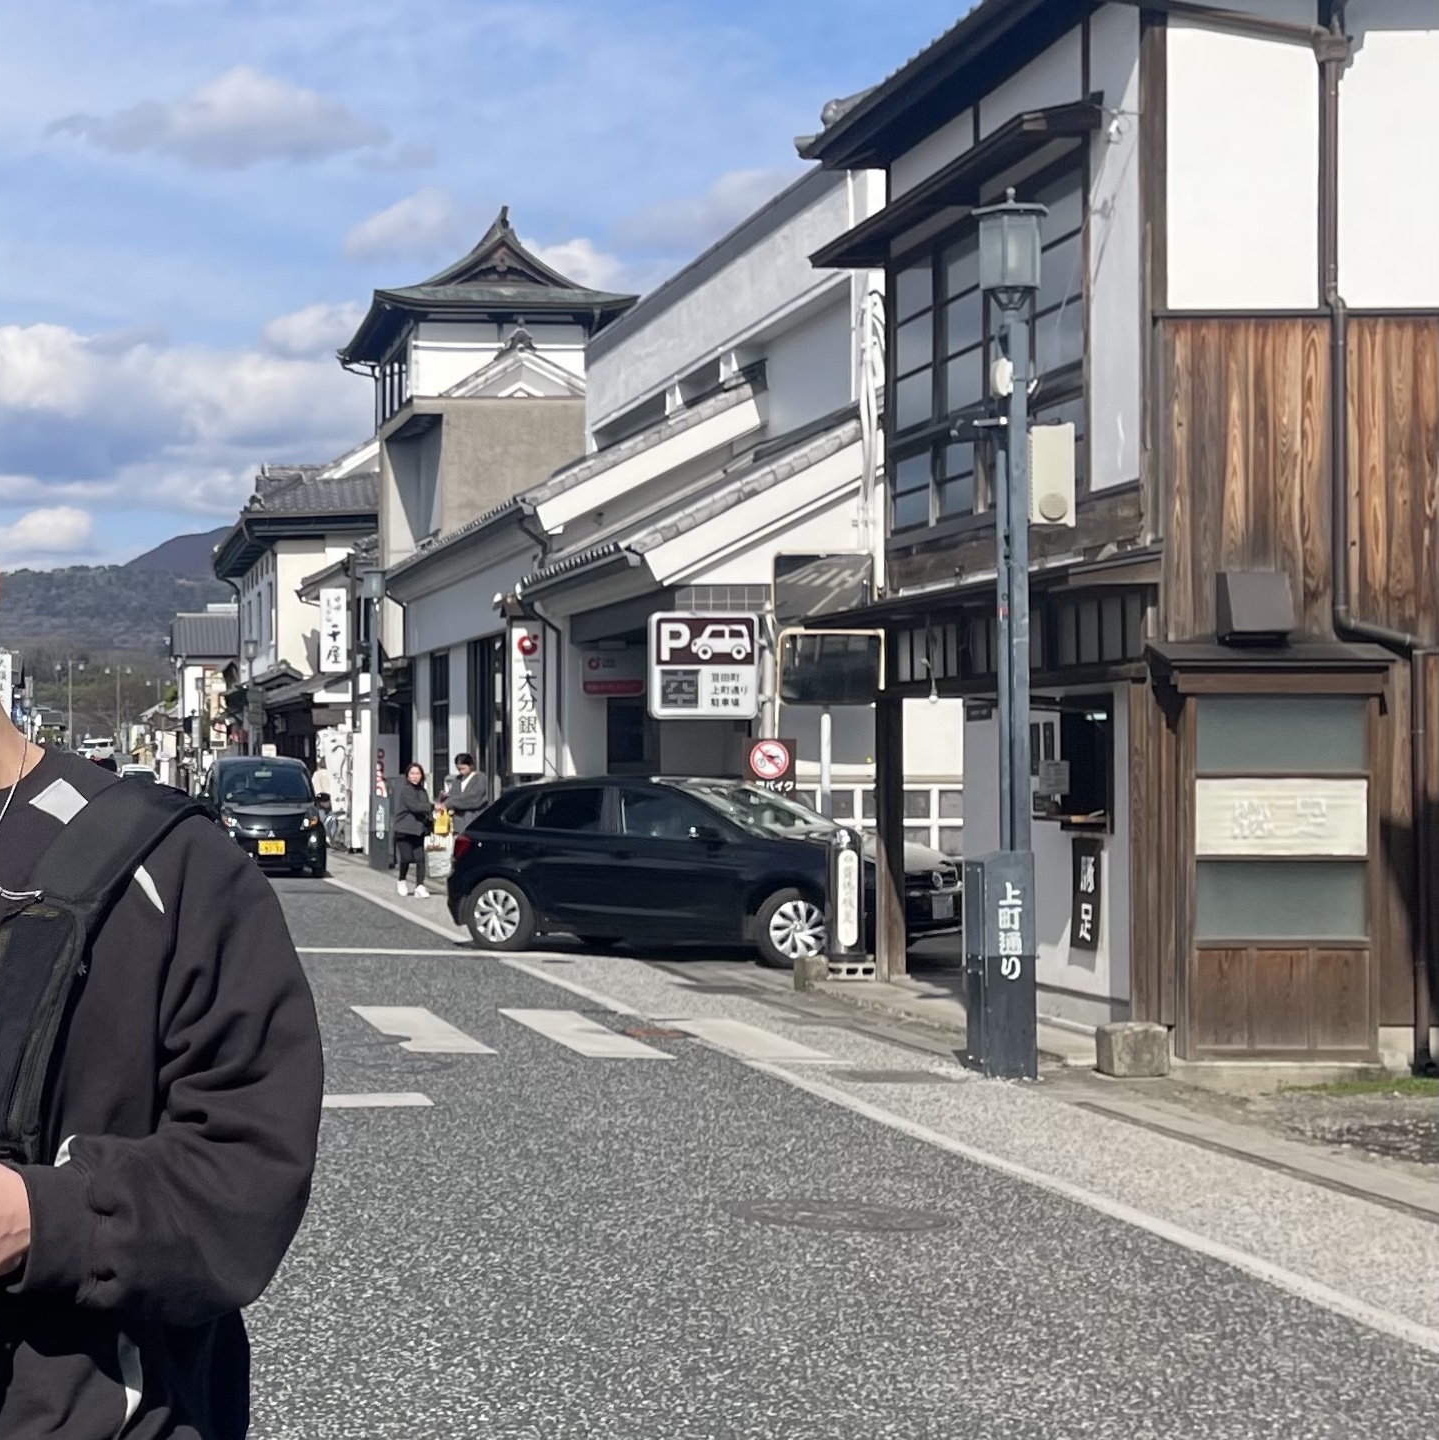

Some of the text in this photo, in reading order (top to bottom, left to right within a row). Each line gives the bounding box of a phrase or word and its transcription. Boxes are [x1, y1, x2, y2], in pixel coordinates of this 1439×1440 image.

[660, 622, 691, 661] P
[710, 685, 748, 695] 上町通り
[710, 698, 740, 708] 駐車場
[517, 671, 538, 756] 大分銀行
[998, 881, 1023, 980] 上町通り
